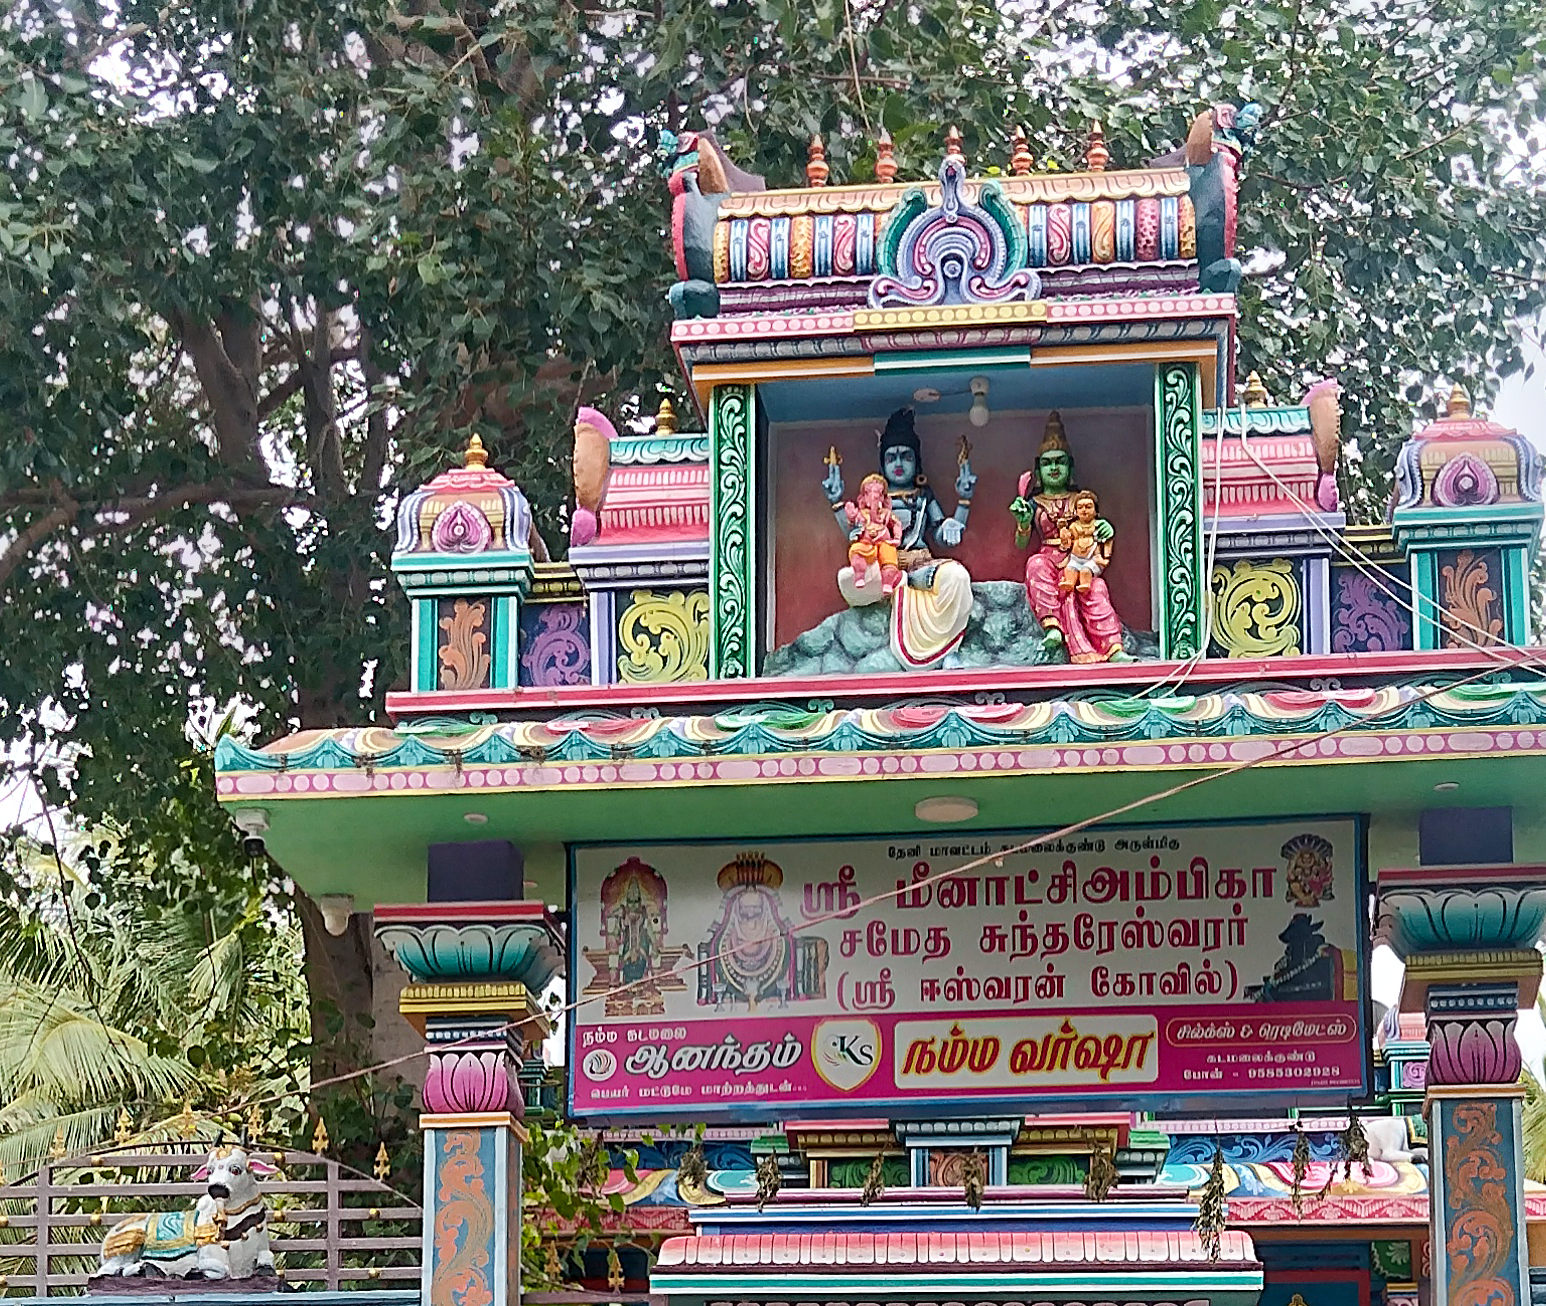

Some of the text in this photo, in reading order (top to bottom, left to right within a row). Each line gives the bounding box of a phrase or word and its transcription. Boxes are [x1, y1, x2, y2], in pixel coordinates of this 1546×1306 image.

[888, 845, 921, 860] தேனி
[930, 841, 991, 857] மாவட்டம்
[1114, 835, 1181, 852] அருள்மிகு
[896, 855, 1277, 909] மீனாட்சிஅம்பிகா
[840, 902, 1249, 964] சமேத சுந்தரேஸ்வரர்
[837, 960, 1239, 1011] (ஸ்ரீ ஈஸ்வரன் கோவில்)
[582, 1026, 687, 1047] நம்ம கடமலை
[1176, 1019, 1347, 1041] சில்க்ஸ் & ரெடிமேட்ஸ்
[624, 1032, 803, 1079] ஆனந்தம்
[901, 1017, 1155, 1083] நம்ம வர்ஷா
[1206, 1049, 1316, 1063] கடமலைக்குண்டு
[1183, 1067, 1223, 1080] போன்
[591, 1084, 629, 1099] பெயர்
[639, 1083, 692, 1098] மட்டுமே
